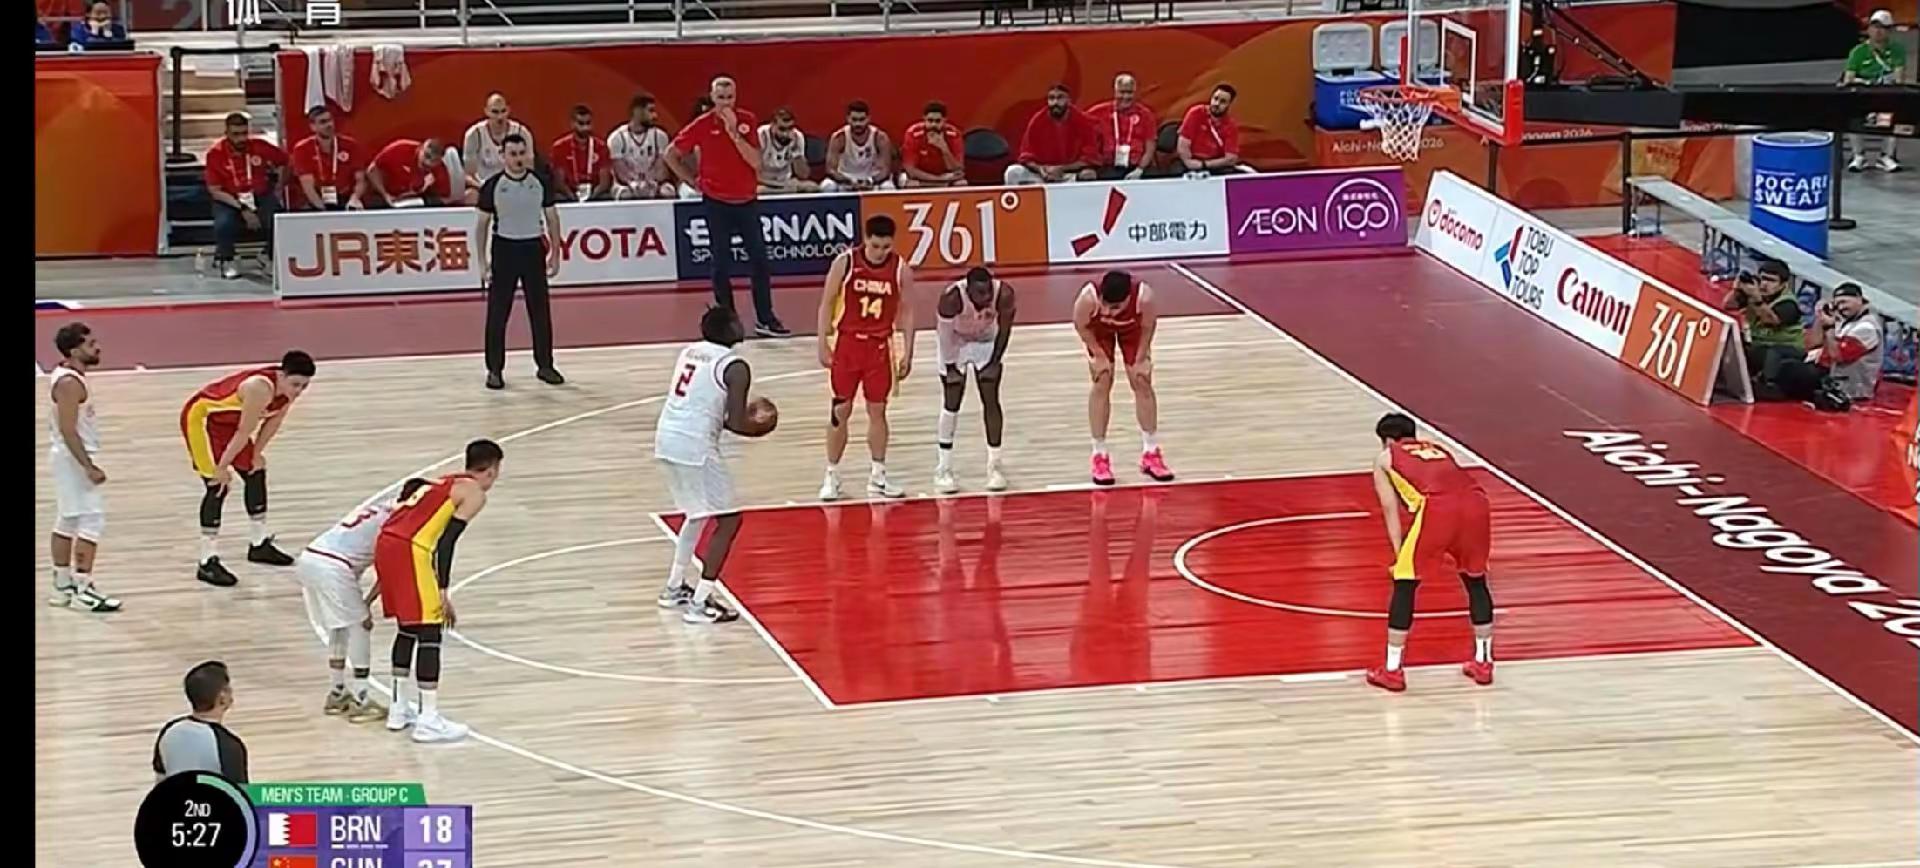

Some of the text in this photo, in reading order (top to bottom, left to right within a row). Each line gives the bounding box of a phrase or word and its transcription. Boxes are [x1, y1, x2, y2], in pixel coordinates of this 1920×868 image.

[1754, 174, 1828, 193] POCARI
[1754, 188, 1822, 206] SWEAT
[1336, 201, 1390, 230] 100
[1127, 220, 1208, 243] 中部電力
[1439, 213, 1484, 251] docomo
[1524, 226, 1554, 259] TOBU
[288, 227, 471, 279] JR東海
[1517, 250, 1540, 276] TOP
[853, 279, 893, 296] CHINA
[1509, 274, 1545, 310] TOURS
[1556, 266, 1632, 337] Canon
[859, 295, 883, 320] 14
[674, 363, 697, 398] 2
[1562, 429, 1891, 595] Aichi-Nagoya
